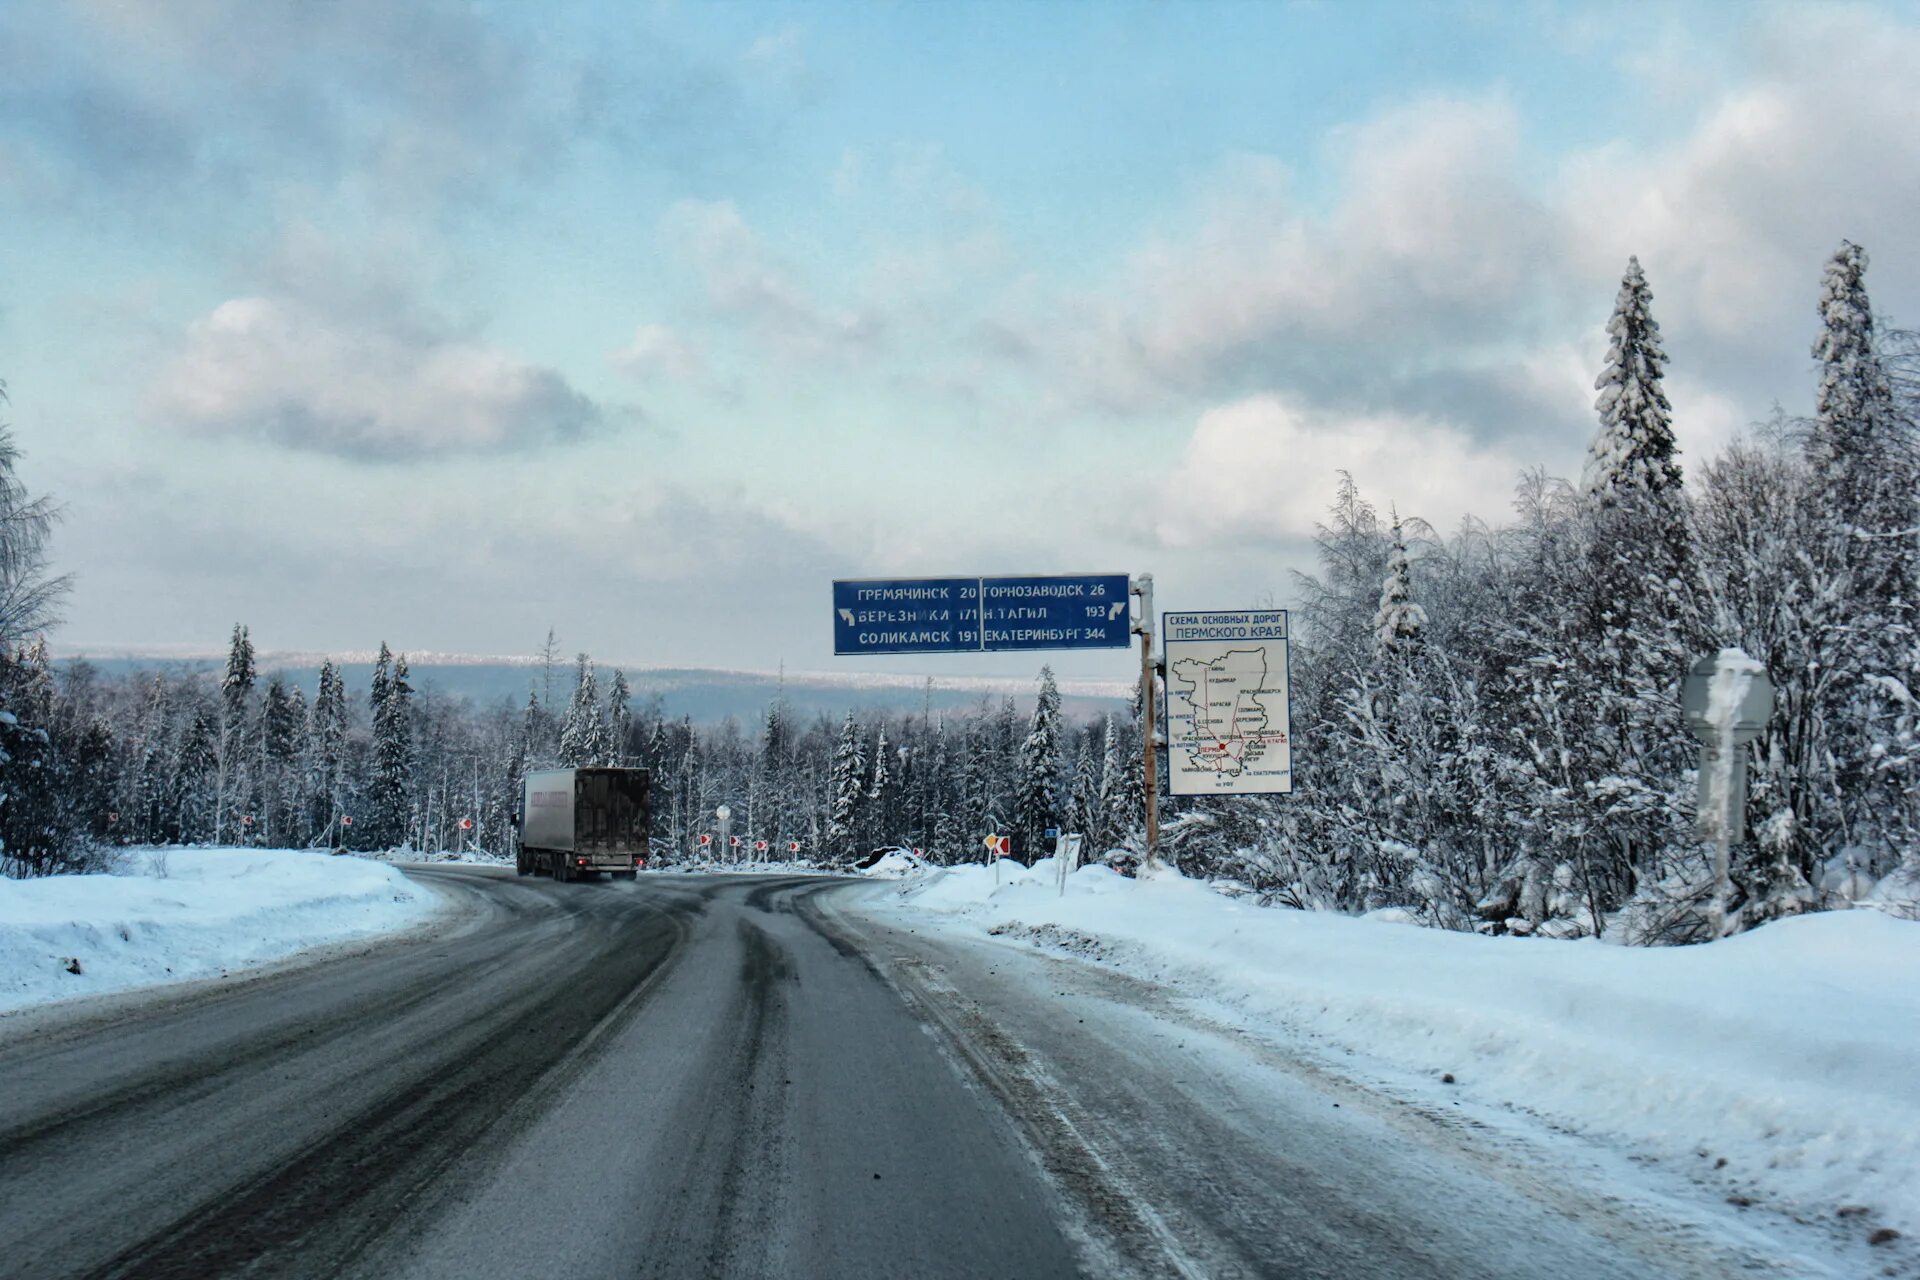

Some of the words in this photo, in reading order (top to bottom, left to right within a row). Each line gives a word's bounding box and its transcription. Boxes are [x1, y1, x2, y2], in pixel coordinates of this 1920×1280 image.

[858, 588, 949, 600] ГРЕМЯЧИНСК
[960, 588, 976, 598] 20
[984, 585, 1083, 597] ГОРНОЗАВОДСК
[1090, 584, 1105, 595] 26
[960, 609, 977, 620] 171
[1085, 606, 1105, 617] 193
[1202, 616, 1249, 624] ОСНОВНЫХ
[1253, 615, 1281, 624] ДОРОГ
[859, 632, 950, 644] СОЛИКАМСК
[958, 632, 977, 641] 191
[985, 629, 1081, 641] ЕКАТЕРИНБУРГ
[1084, 628, 1105, 639] 344
[1177, 627, 1246, 638] ПЕРМСКОГО
[1251, 627, 1281, 636] КРАЯ
